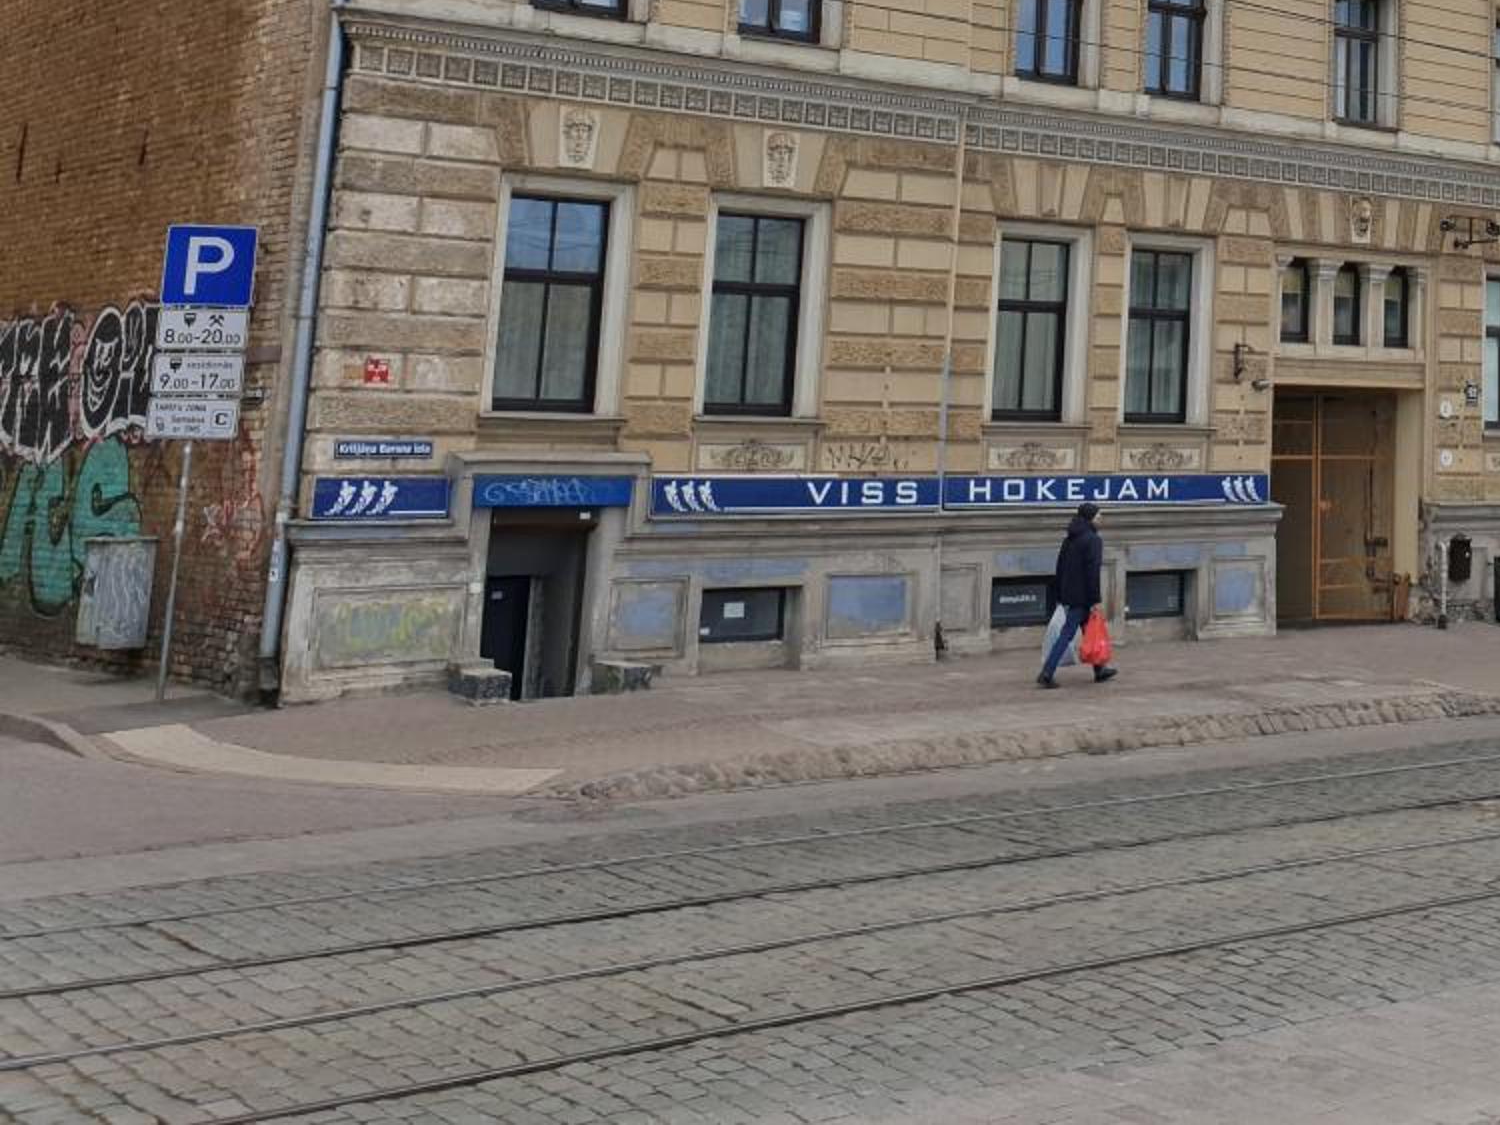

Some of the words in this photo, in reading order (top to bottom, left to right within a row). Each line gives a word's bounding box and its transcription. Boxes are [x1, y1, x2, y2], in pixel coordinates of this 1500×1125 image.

[183, 236, 235, 295] P
[215, 412, 228, 426] C
[808, 481, 918, 505] VISS
[968, 478, 1171, 502] HOKEJAM
